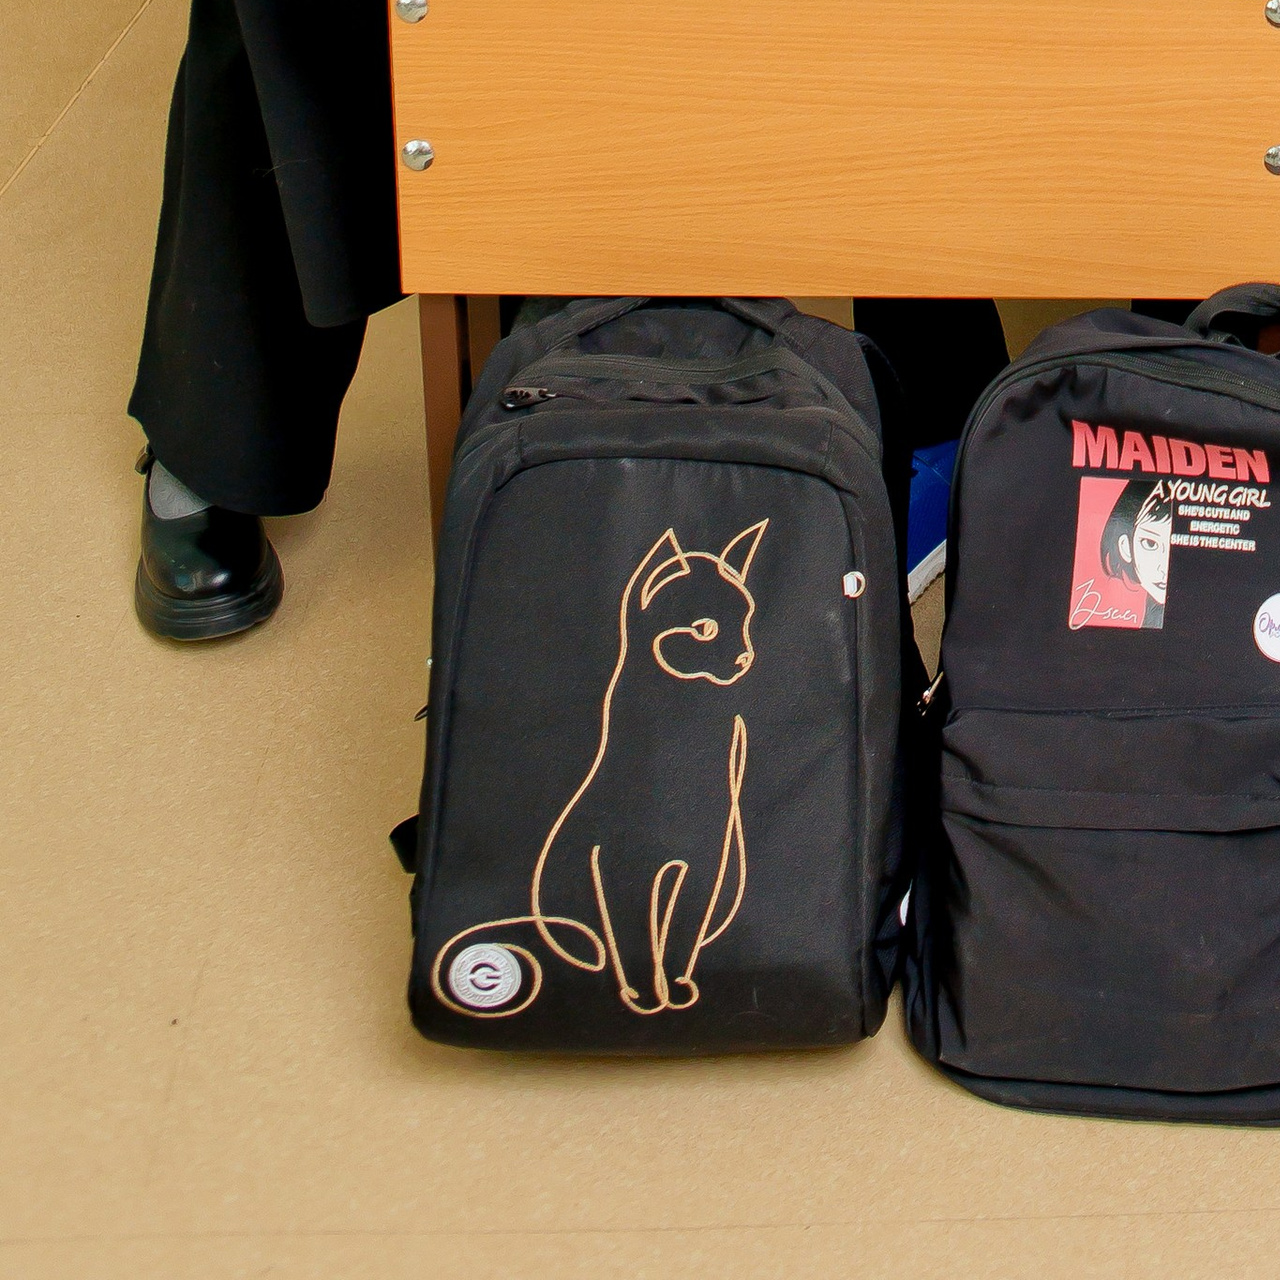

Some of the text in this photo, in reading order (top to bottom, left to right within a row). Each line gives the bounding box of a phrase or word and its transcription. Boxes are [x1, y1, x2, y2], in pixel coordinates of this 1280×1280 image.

[1072, 419, 1270, 483] MAIDEN
[1167, 478, 1229, 506] YOUNG
[1229, 486, 1271, 508] GIRL
[1178, 504, 1251, 521] SHE'S CUTE AND
[1189, 520, 1240, 535] ENERGETIC
[1170, 534, 1189, 546] SHE
[1199, 536, 1218, 549] THE
[1218, 537, 1256, 551] CENTER
